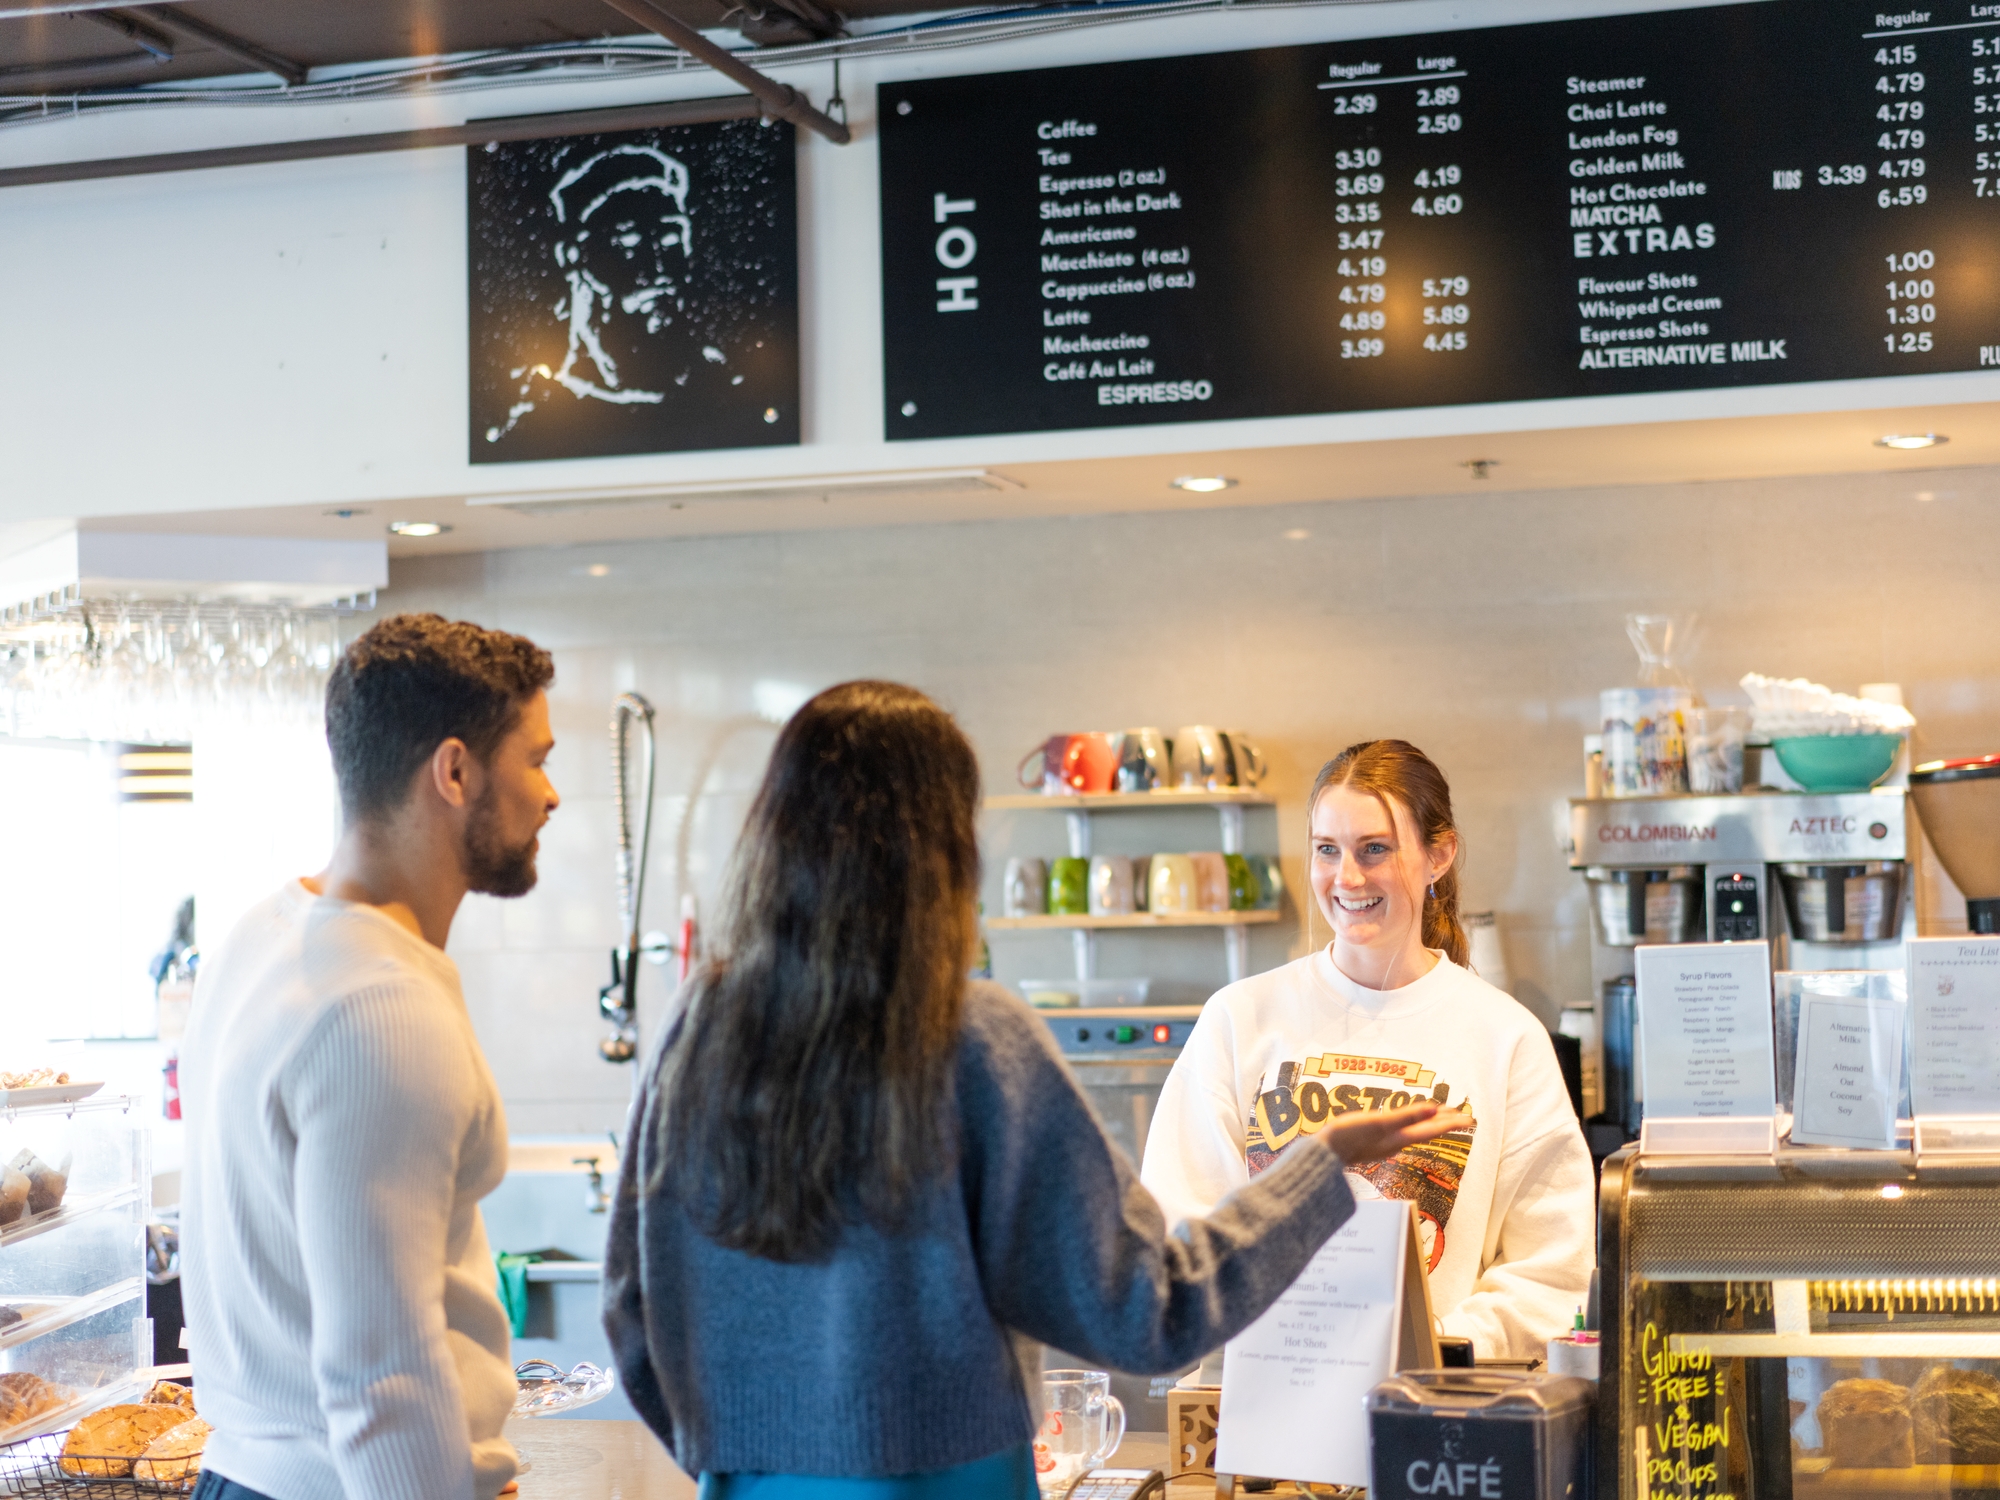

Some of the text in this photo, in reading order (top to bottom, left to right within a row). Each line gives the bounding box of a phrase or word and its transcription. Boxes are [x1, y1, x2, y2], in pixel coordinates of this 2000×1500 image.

[1876, 10, 1931, 28] Regular
[1874, 45, 1916, 65] 4.15
[1330, 57, 1456, 79] Regular Large
[1567, 77, 1646, 94] Steamer
[1876, 72, 1925, 93] 4.79
[1334, 86, 1460, 114] 2.39 2.89
[1568, 101, 1666, 122] Chai Latte
[1877, 101, 1924, 121] 4.79
[1038, 120, 1097, 139] Coffee
[1418, 114, 1461, 134] 2.50
[1569, 125, 1678, 149] London Fog
[1878, 129, 1925, 150] 4.79
[1038, 149, 1070, 166] Tea
[1336, 148, 1381, 170] 3.30
[1569, 152, 1684, 177] Golden Milk
[1878, 158, 1925, 178] 4.79
[1039, 175, 1115, 195] Espresso
[1336, 165, 1461, 196] 3.69 4.19
[1773, 165, 1866, 189] KIDS 3.39
[1571, 180, 1706, 205] Hot Chocolate
[1878, 185, 1927, 208] 6.59
[1040, 192, 1181, 219] Shot in the Dark
[1335, 194, 1462, 223] 3.35 4.60
[1571, 204, 1662, 227] MATCHA
[1040, 227, 1136, 246] Americano
[1338, 230, 1384, 250] 3.47
[1574, 223, 1715, 257] EXTRAS
[935, 194, 978, 312] HOT
[1041, 252, 1134, 272] Macchiato
[1886, 250, 1935, 272] 1.00
[1338, 257, 1386, 277] 4.19
[1042, 277, 1146, 301] Cappuccino
[1339, 277, 1469, 303] 4.79 5.79
[1579, 273, 1697, 295] Flavour Shots
[1886, 279, 1935, 300] 1.00
[1044, 310, 1090, 326] Latte
[1340, 305, 1469, 330] 4.89 5.89
[1579, 295, 1721, 320] Whipped Cream
[1887, 303, 1936, 324] 1.30
[1580, 320, 1709, 346] Espresso Shots
[1884, 332, 1933, 352] 1.25
[1044, 334, 1149, 354] Mochaccino
[1341, 332, 1467, 358] 3.99 4.45
[1579, 340, 1786, 369] ALTERNATIVE MILK
[1044, 359, 1154, 381] Café Au Lait
[1098, 380, 1212, 405] ESPRESSO
[1598, 825, 1716, 844] COLOMBIAN
[1789, 815, 1856, 835] AZTEC
[1958, 946, 1999, 957] Tea List
[1680, 973, 1702, 981] Syrup
[1830, 1023, 1871, 1033] Alternative
[1839, 1035, 1861, 1044] Milks
[1833, 1063, 1864, 1072] Almond
[1840, 1078, 1854, 1086] Oat
[1830, 1091, 1862, 1101] Coconut
[1256, 1082, 1441, 1151] BOSTO
[1838, 1106, 1852, 1116] Soy
[1284, 1337, 1327, 1349] Hot Shots
[1642, 1322, 1712, 1376] Gluten
[1651, 1375, 1710, 1405] FREE
[1655, 1406, 1730, 1453] VEGAN
[1406, 1456, 1502, 1499] CAFÉ
[1675, 1460, 1718, 1489] Cups
